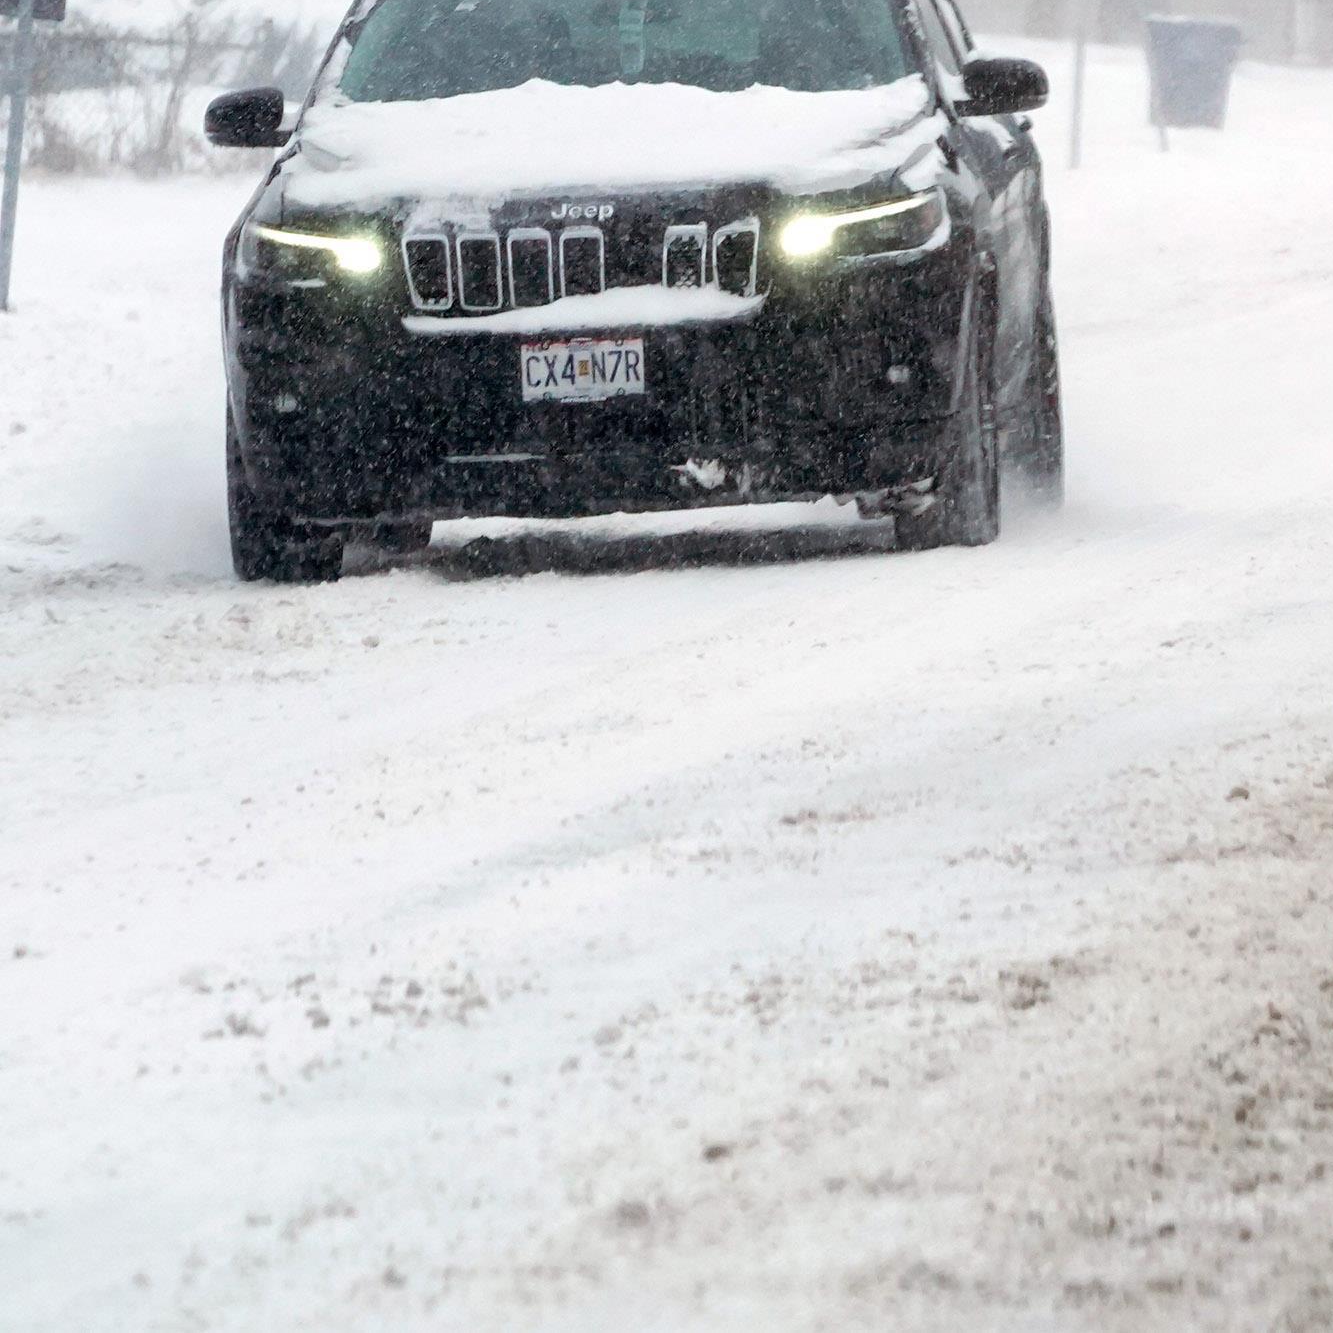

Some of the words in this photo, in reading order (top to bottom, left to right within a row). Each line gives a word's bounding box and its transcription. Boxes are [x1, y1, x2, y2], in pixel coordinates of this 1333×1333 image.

[550, 203, 614, 222] Jeep
[525, 353, 577, 388] CX4
[590, 348, 641, 385] N7R
